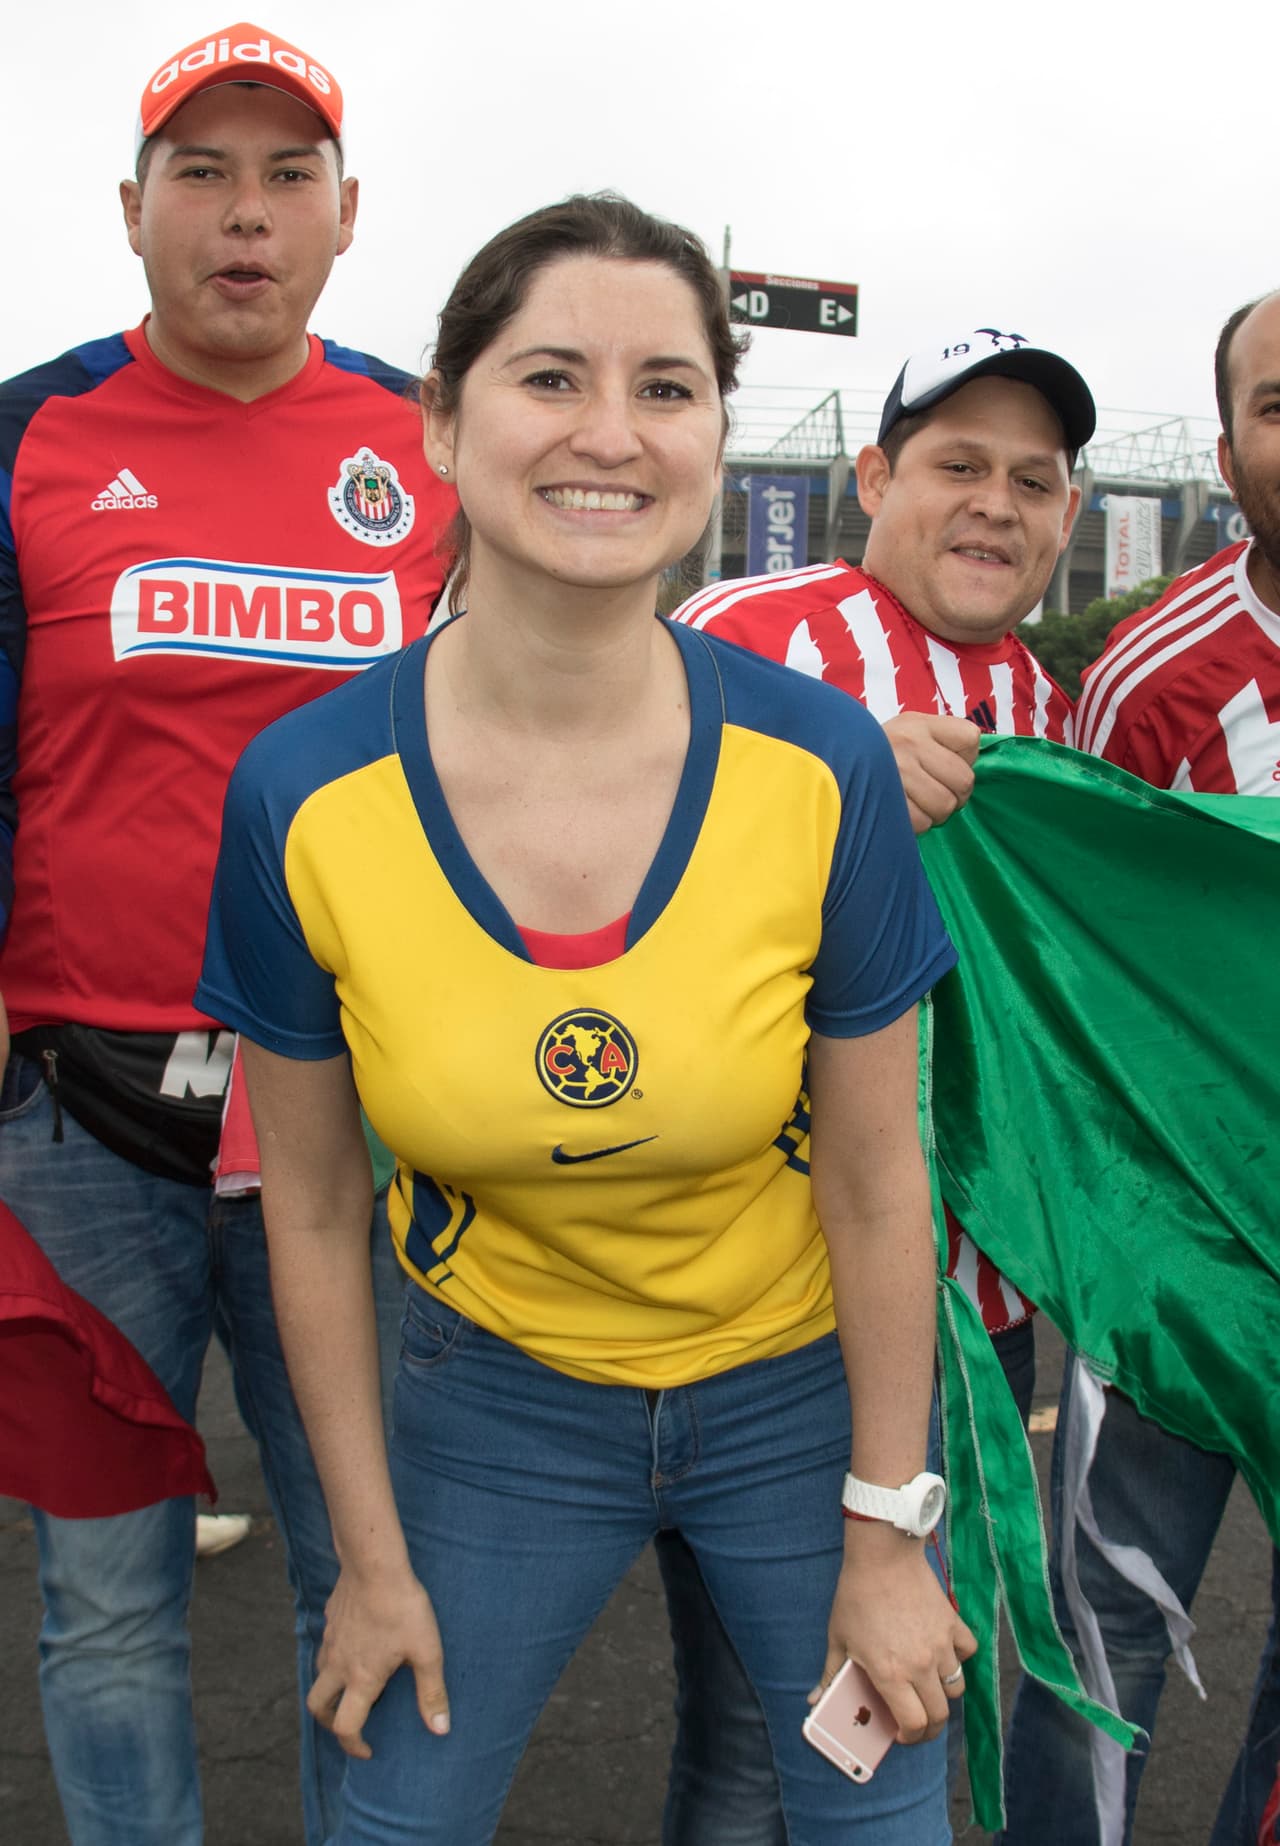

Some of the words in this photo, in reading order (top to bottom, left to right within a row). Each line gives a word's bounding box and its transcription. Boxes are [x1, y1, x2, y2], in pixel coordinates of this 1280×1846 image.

[152, 39, 331, 94] adidas
[765, 275, 819, 291] Secciones
[749, 290, 769, 318] D
[820, 299, 836, 326] E
[941, 343, 970, 360] 19
[91, 494, 158, 511] adidas
[1115, 511, 1130, 580] TOTAL
[138, 579, 385, 647] BIMBO
[546, 1044, 576, 1076] C
[601, 1042, 628, 1073] A
